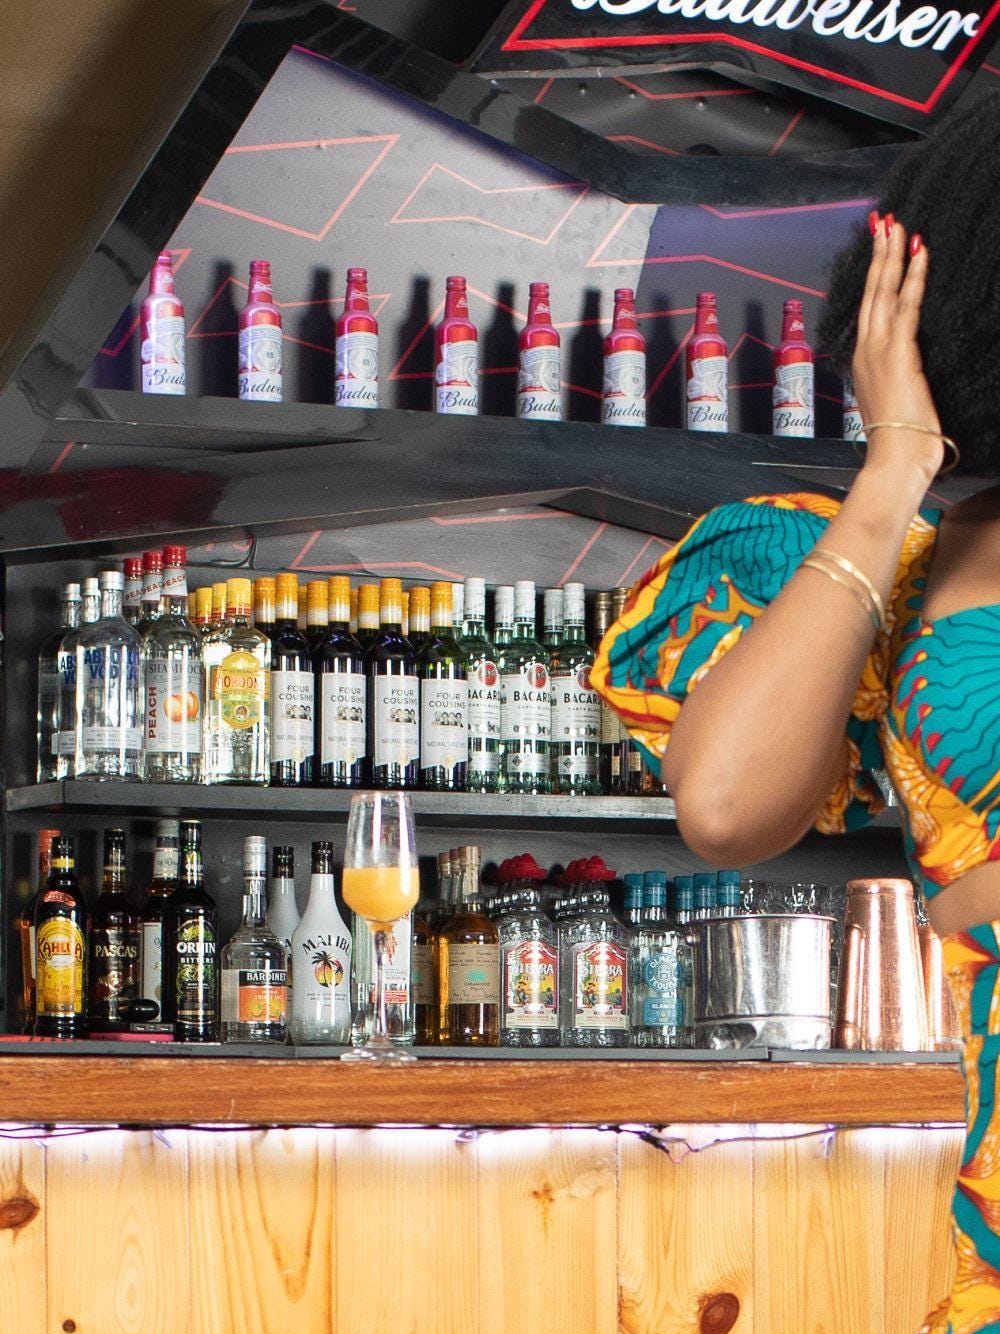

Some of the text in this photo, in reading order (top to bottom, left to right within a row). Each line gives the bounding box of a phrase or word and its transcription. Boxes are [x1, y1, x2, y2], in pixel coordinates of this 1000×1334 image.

[571, 0, 980, 51] weiser
[60, 655, 76, 670] AB
[84, 649, 140, 665] ABOU
[90, 664, 137, 679] VODA
[149, 663, 202, 674] SHAMOC
[287, 684, 310, 693] FOUR
[339, 687, 361, 695] FOUR
[391, 689, 414, 697] FOUR
[428, 700, 466, 709] COUINS
[148, 686, 158, 739] PEACH
[176, 941, 216, 954] ORIN
[512, 959, 555, 977] SIERA
[580, 961, 624, 978] SIRA
[246, 972, 287, 981] BARDINET
